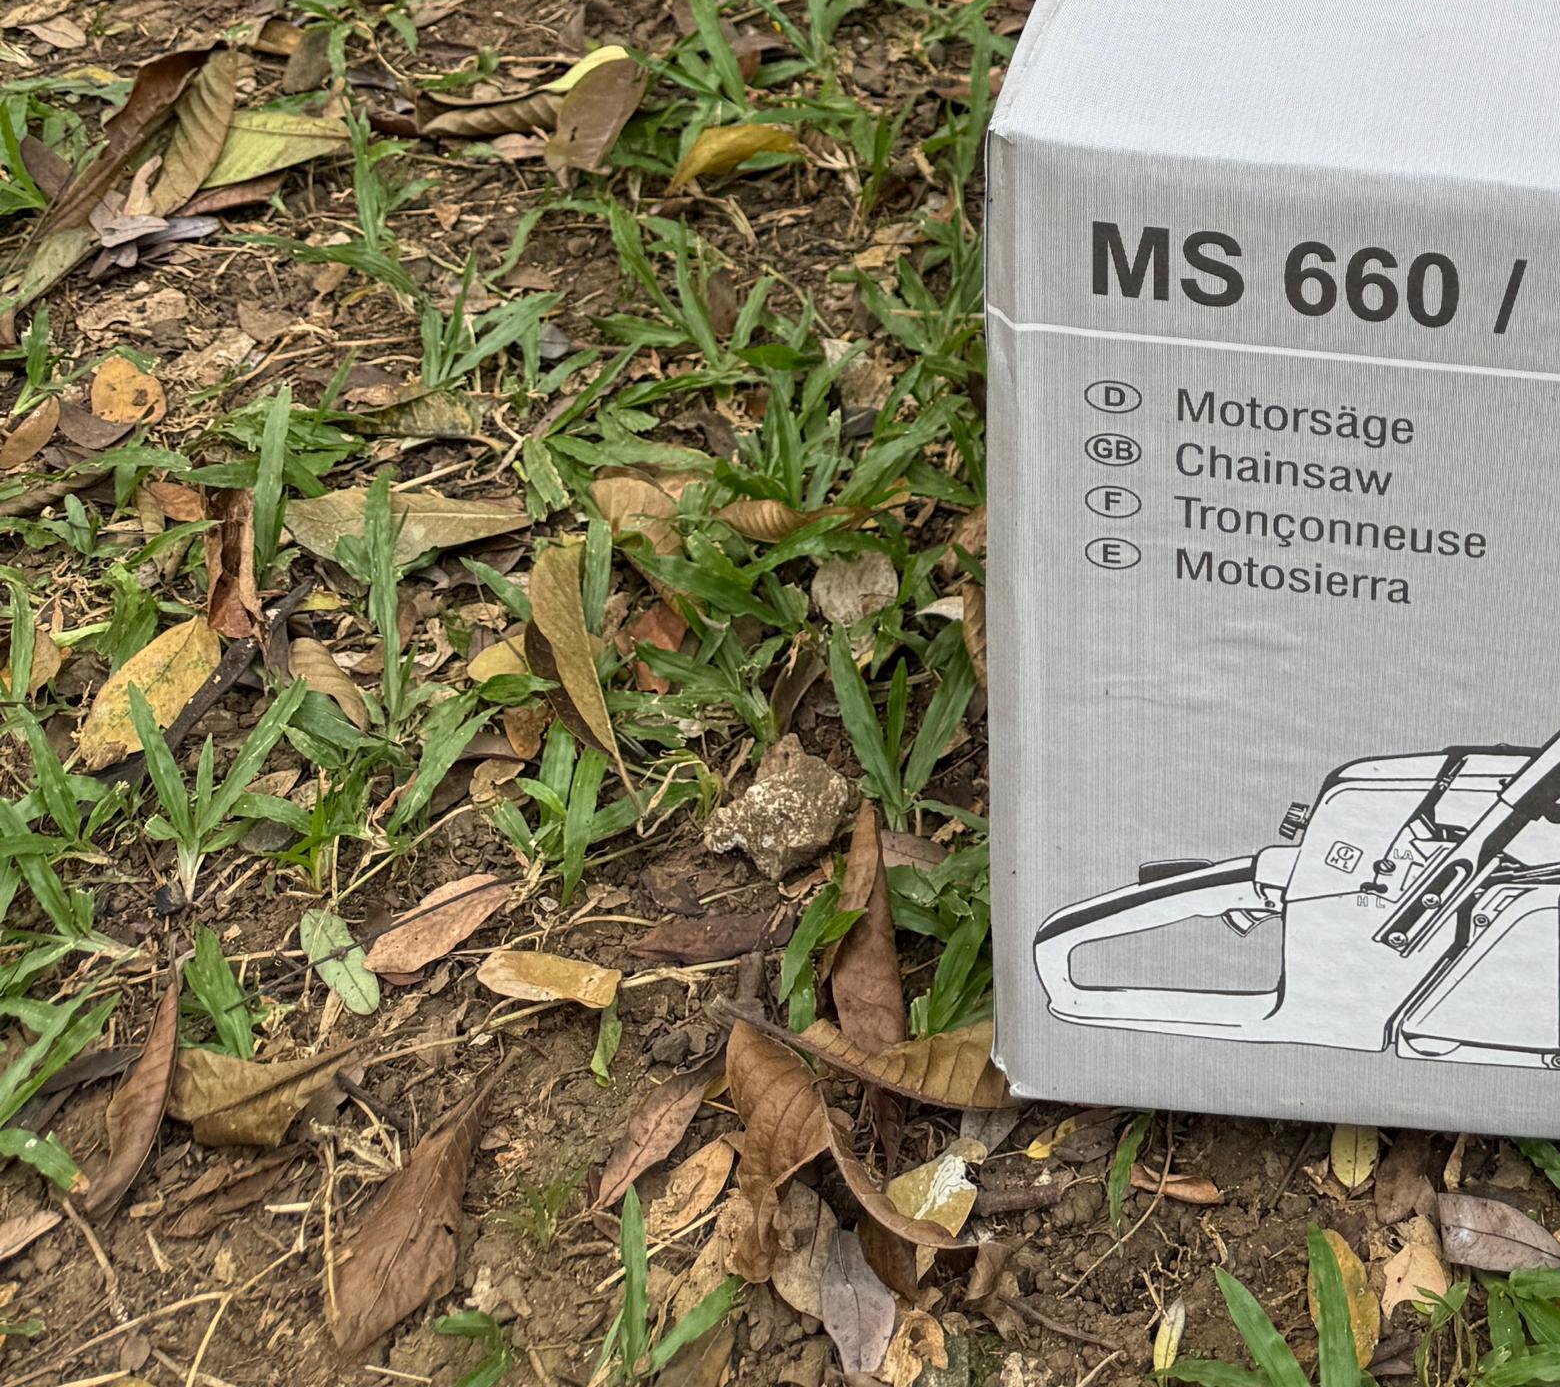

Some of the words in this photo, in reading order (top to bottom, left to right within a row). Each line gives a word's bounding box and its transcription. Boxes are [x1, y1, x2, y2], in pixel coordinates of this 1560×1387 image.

[1091, 220, 1246, 308] MS
[1284, 240, 1460, 328] 660
[1492, 259, 1527, 334] /
[1175, 386, 1415, 449] Motorsäge
[1093, 438, 1134, 461] GB
[1175, 441, 1394, 496] Chainsaw
[1173, 495, 1488, 560] Tronçonneuse
[1173, 547, 1411, 605] Motosierra
